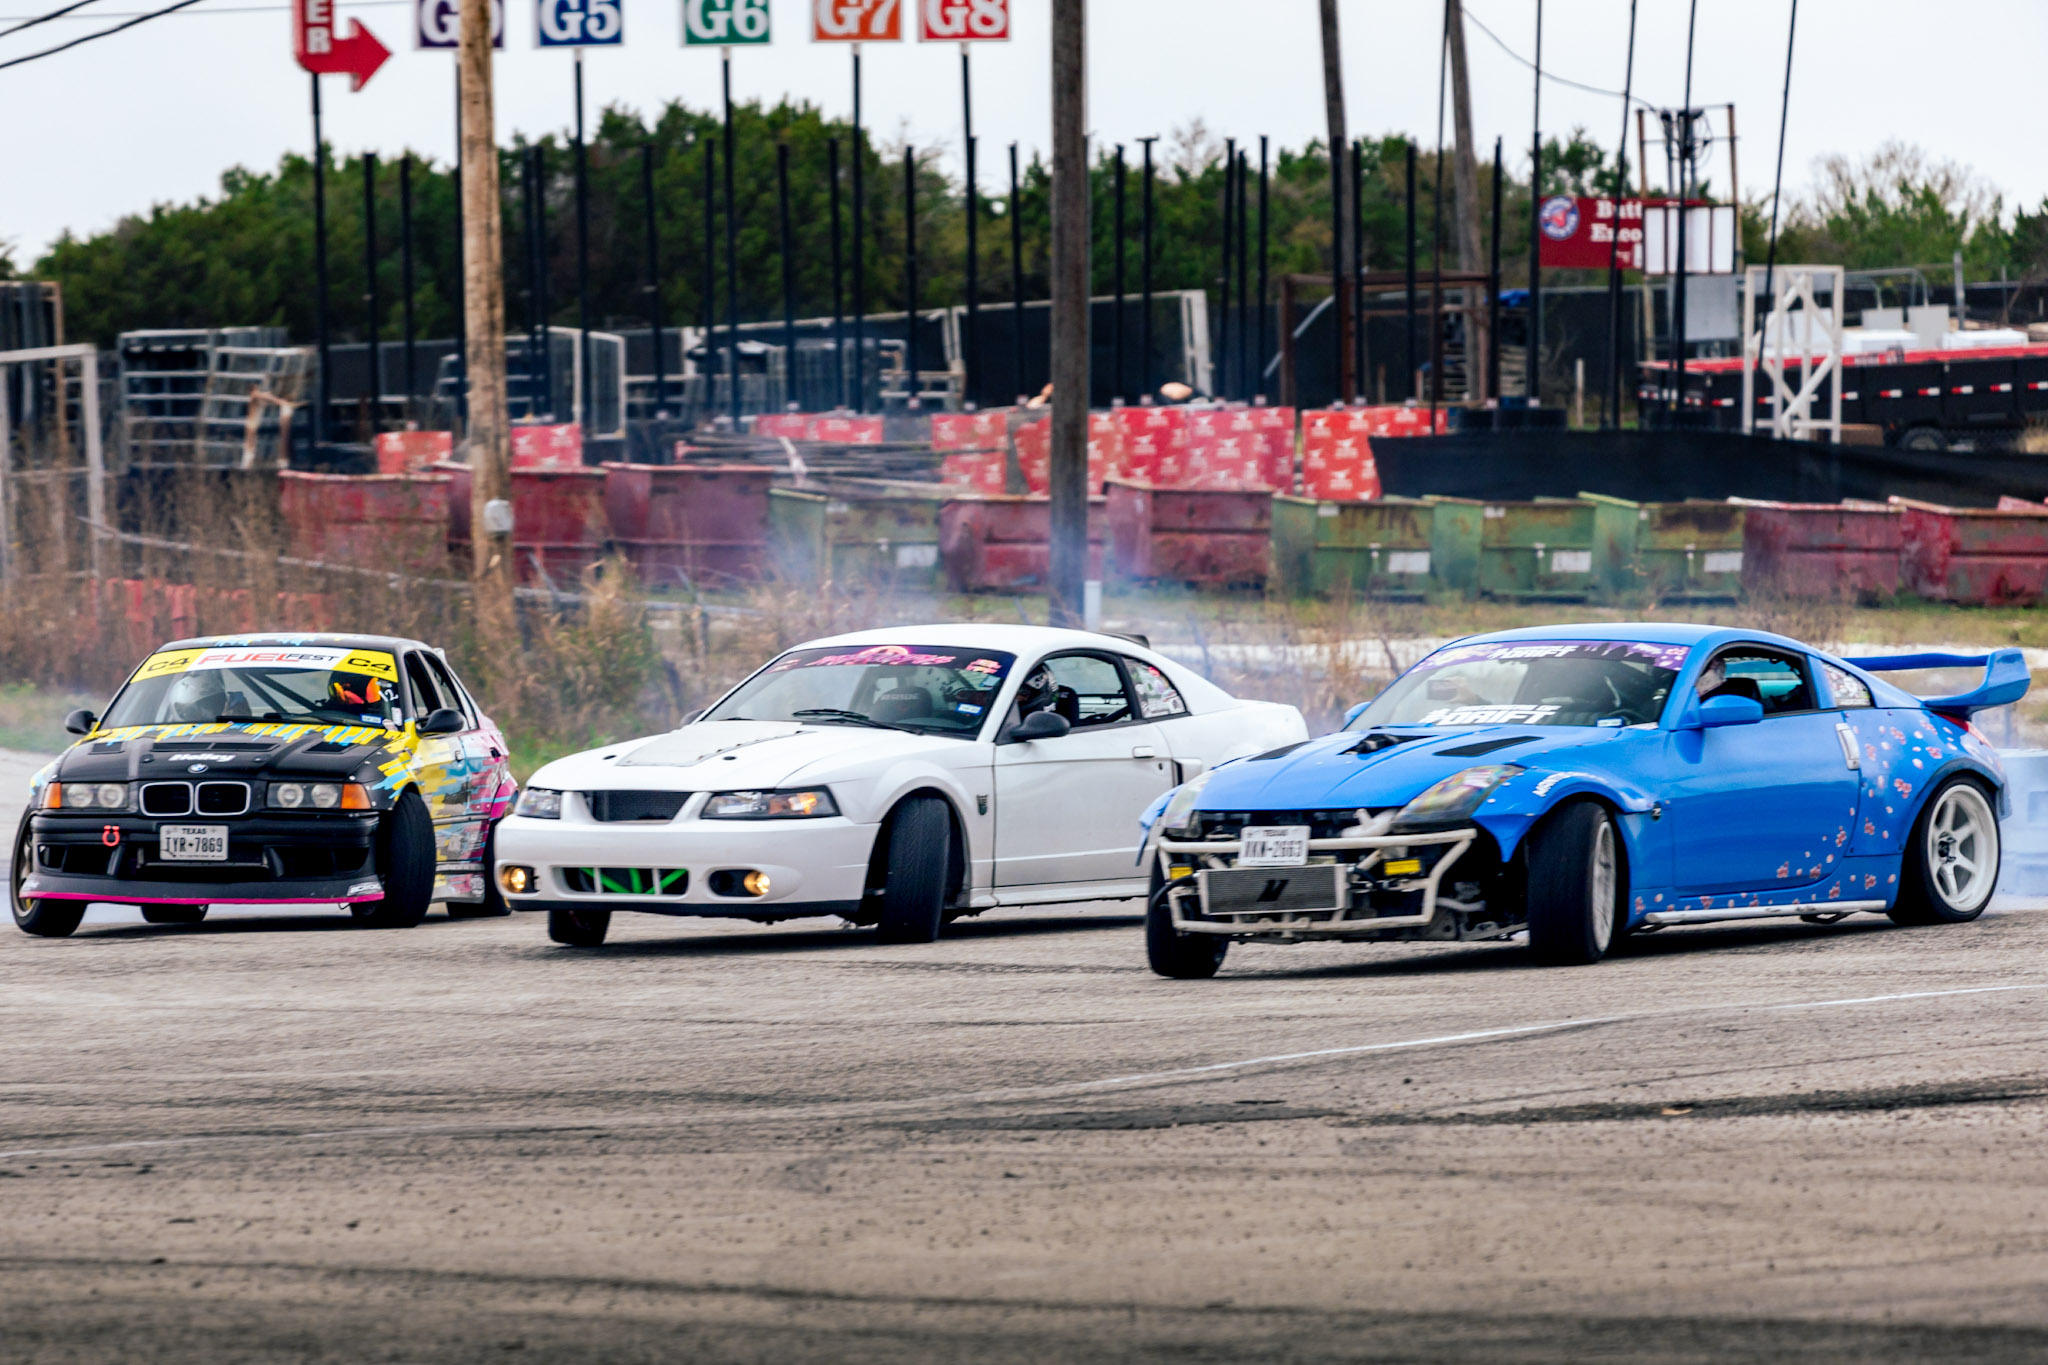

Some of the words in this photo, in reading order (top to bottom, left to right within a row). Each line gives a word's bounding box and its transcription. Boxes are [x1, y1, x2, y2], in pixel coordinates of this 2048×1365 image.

[540, 0, 620, 40] G5
[686, 0, 769, 39] G6
[817, 0, 897, 35] G7
[926, 0, 1006, 35] G8
[347, 658, 392, 672] C4
